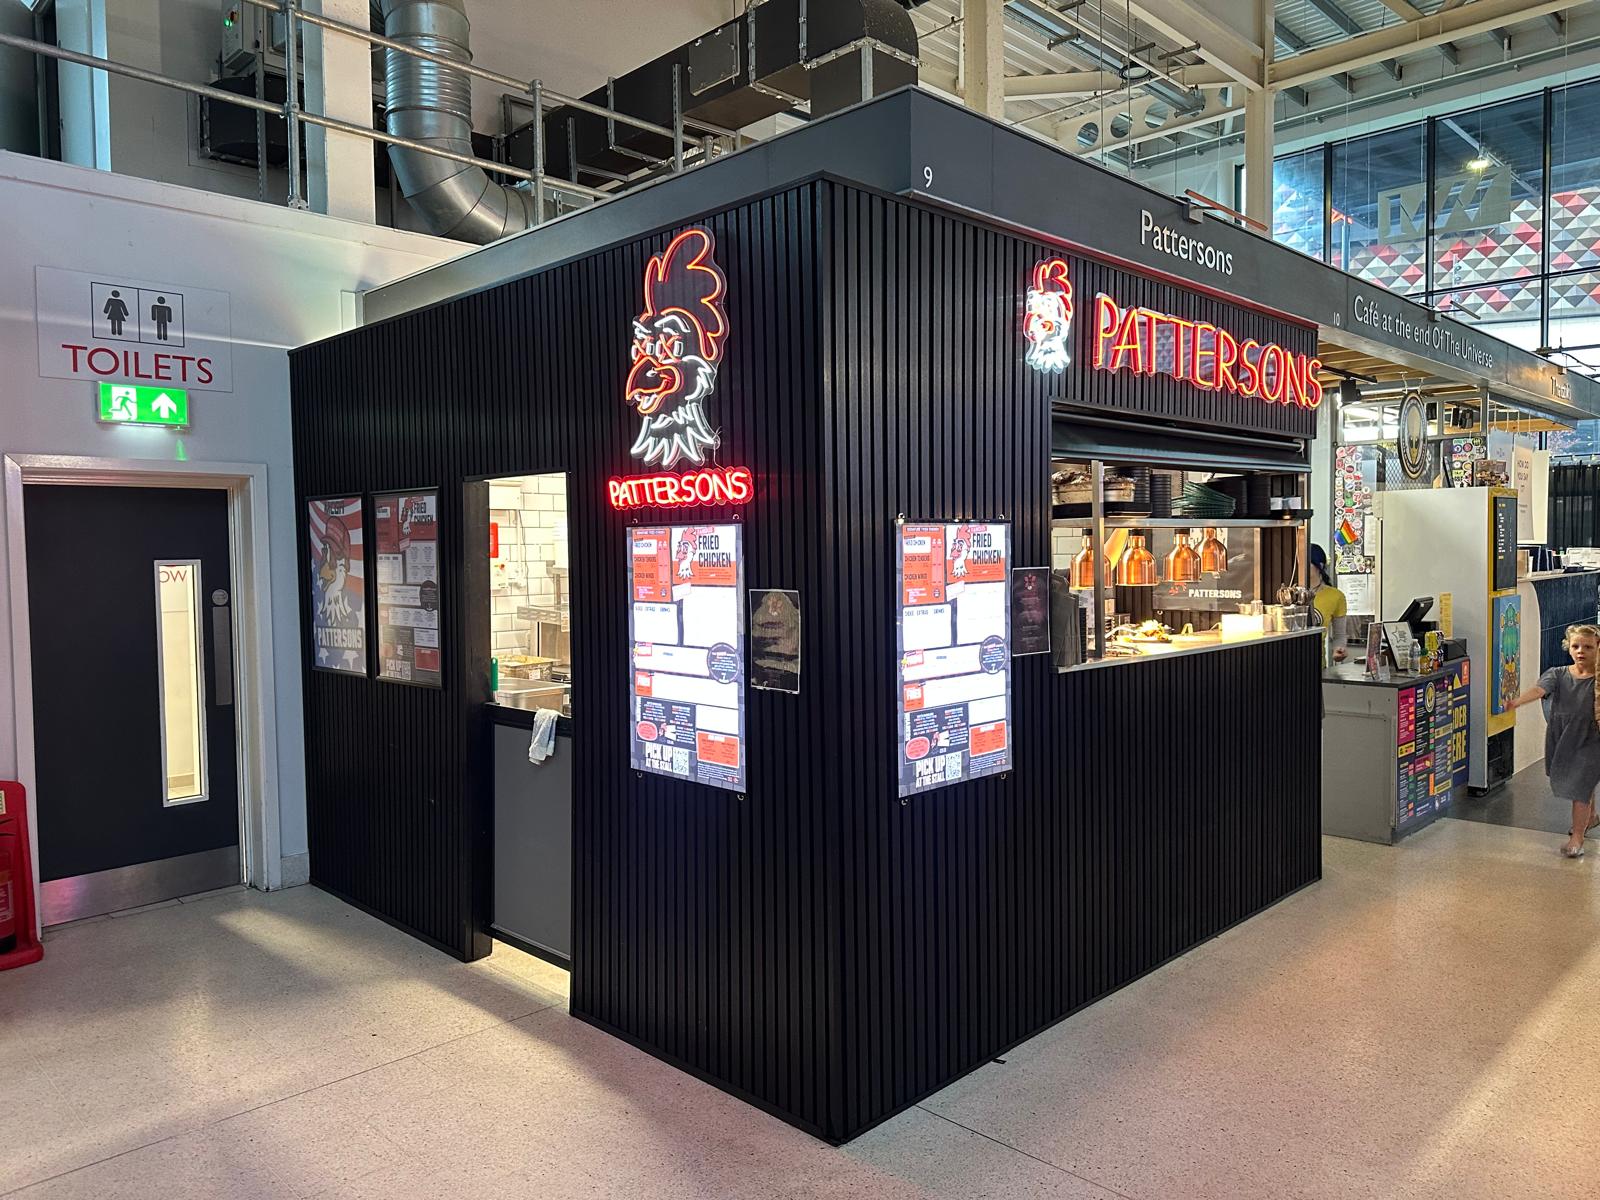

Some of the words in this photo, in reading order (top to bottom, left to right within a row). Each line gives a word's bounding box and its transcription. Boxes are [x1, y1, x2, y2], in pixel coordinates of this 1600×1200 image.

[923, 165, 933, 188] 9
[1140, 208, 1234, 276] Pattersons
[1353, 294, 1379, 327] Café
[1382, 312, 1392, 332] at
[1395, 312, 1411, 339] the
[1414, 323, 1430, 346] end
[1432, 326, 1445, 350] Of
[1445, 331, 1460, 357] The
[1461, 336, 1493, 368] Universe
[1093, 292, 1323, 410] PATTERSONS
[62, 343, 213, 384] TOILETS
[609, 472, 748, 506] PATTERSONS
[413, 502, 427, 514] FRIED
[698, 535, 720, 550] FRIED
[972, 533, 992, 548] FRIED
[698, 552, 732, 568] CHICKEN
[972, 549, 1002, 565] CHICKEN
[1188, 589, 1242, 599] PATTERSONS
[318, 628, 363, 648] PATTERSONS
[1453, 704, 1467, 729] DER
[645, 743, 662, 760] PICK
[663, 745, 673, 761] UP
[915, 757, 933, 777] PICK
[934, 755, 945, 773] UP
